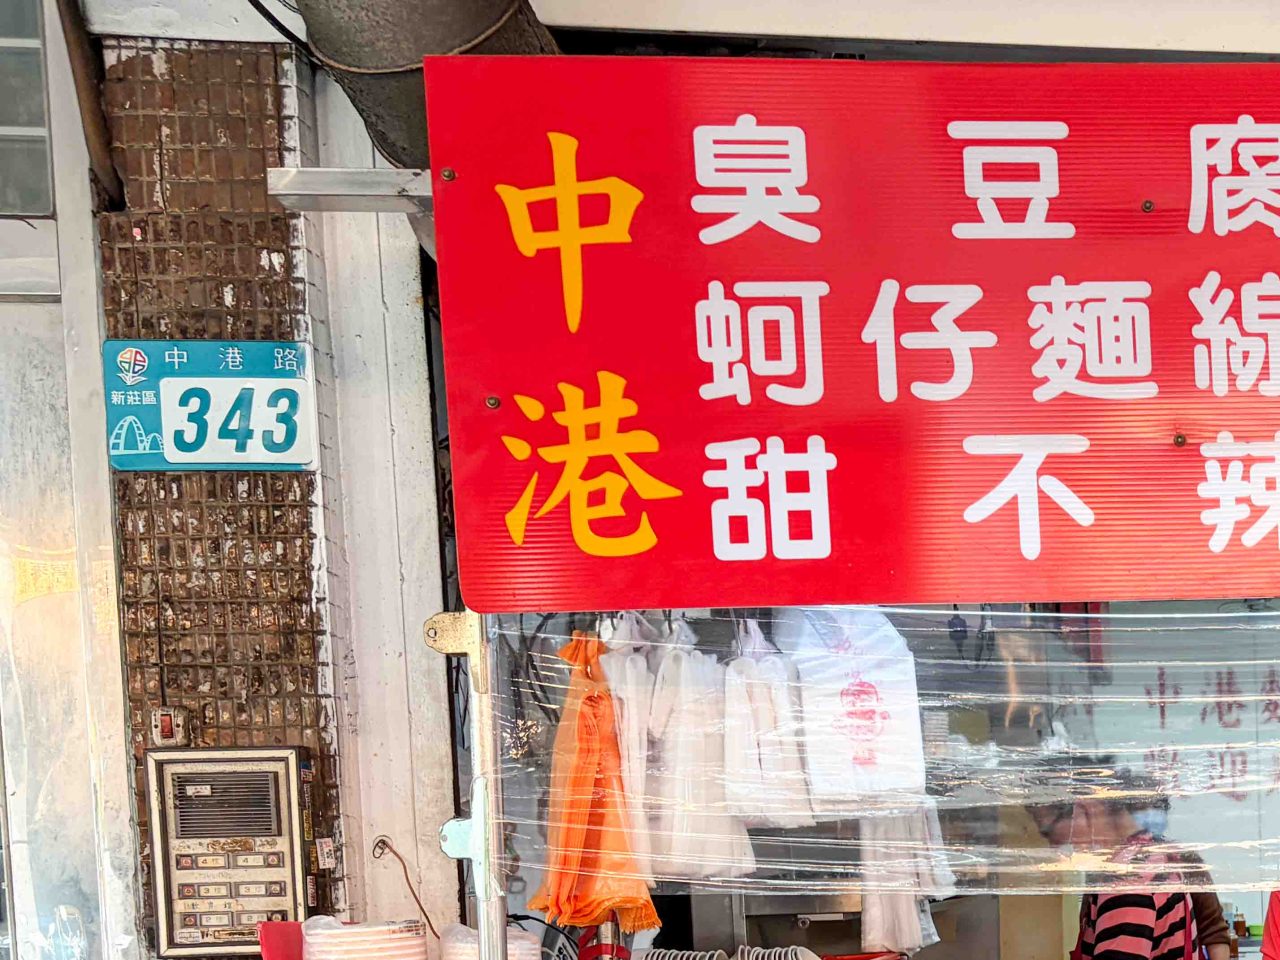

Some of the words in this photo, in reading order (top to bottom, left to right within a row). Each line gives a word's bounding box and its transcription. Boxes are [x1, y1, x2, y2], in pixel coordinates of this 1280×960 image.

[165, 346, 298, 371] 中港路
[496, 133, 682, 556] 中港
[111, 390, 157, 406] 新莊區
[174, 386, 301, 453] 343
